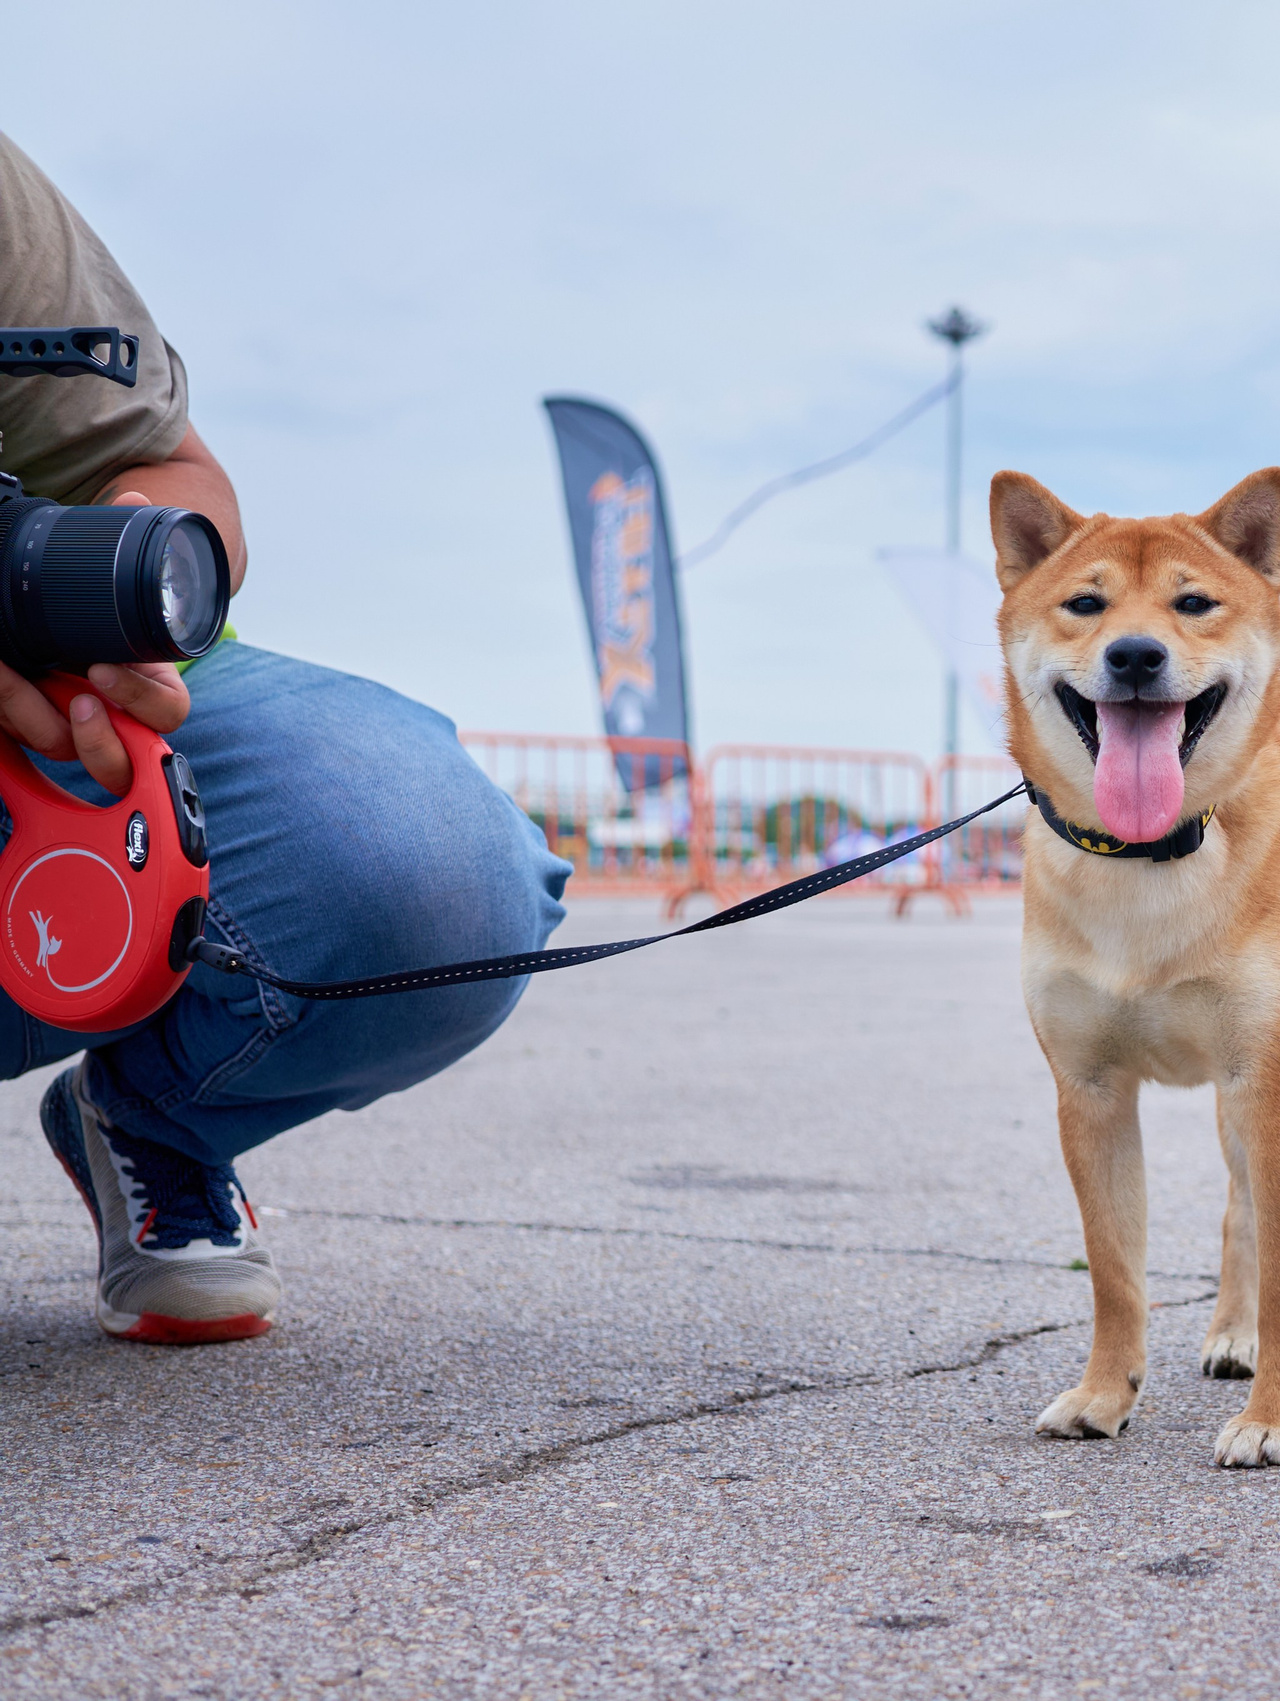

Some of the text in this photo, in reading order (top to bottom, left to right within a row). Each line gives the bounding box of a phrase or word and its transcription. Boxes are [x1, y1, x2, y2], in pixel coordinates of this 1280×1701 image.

[26, 540, 34, 549] 100
[133, 822, 145, 854] flexi
[10, 940, 15, 948] IN
[12, 949, 34, 978] GERMANY
